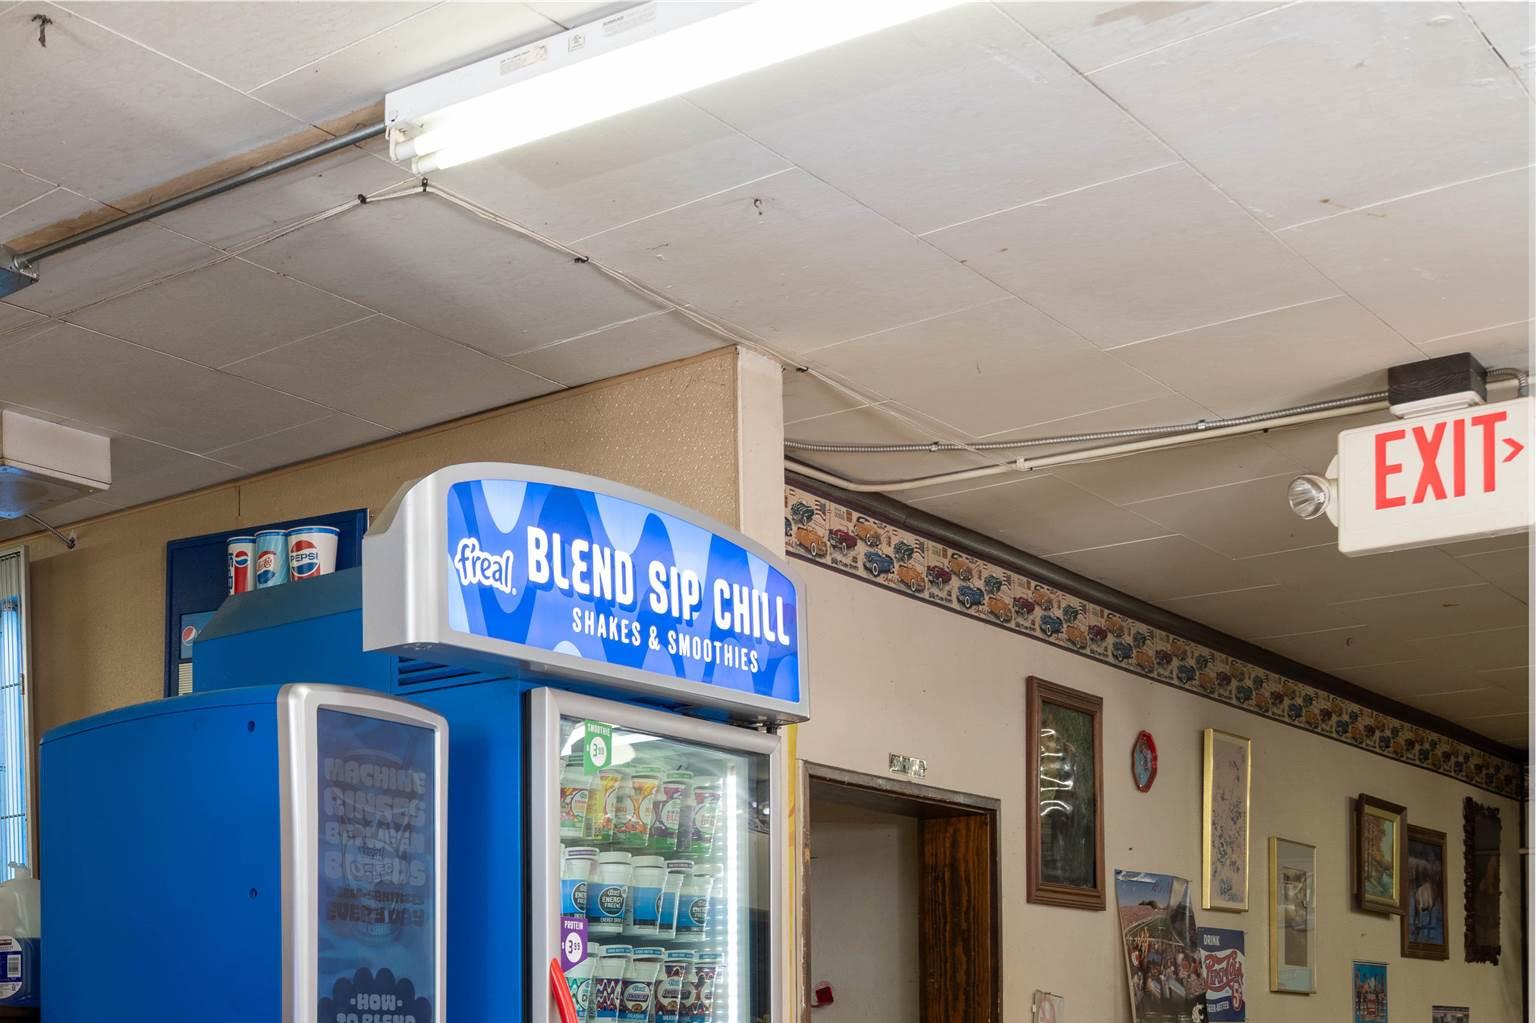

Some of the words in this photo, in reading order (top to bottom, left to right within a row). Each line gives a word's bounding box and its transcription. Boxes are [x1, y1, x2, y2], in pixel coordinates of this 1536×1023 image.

[1375, 411, 1507, 510] EXIT
[291, 552, 319, 562] PEPSI
[527, 526, 634, 605] BLEND
[649, 560, 702, 621] SIP
[714, 579, 790, 645] CHILL
[572, 607, 641, 647] SHAKES
[648, 625, 661, 651] &
[667, 632, 759, 673] SMOOTHIES
[324, 757, 426, 794] MACHINE
[564, 920, 584, 929] PROTEIN
[1204, 934, 1220, 945] DRINK
